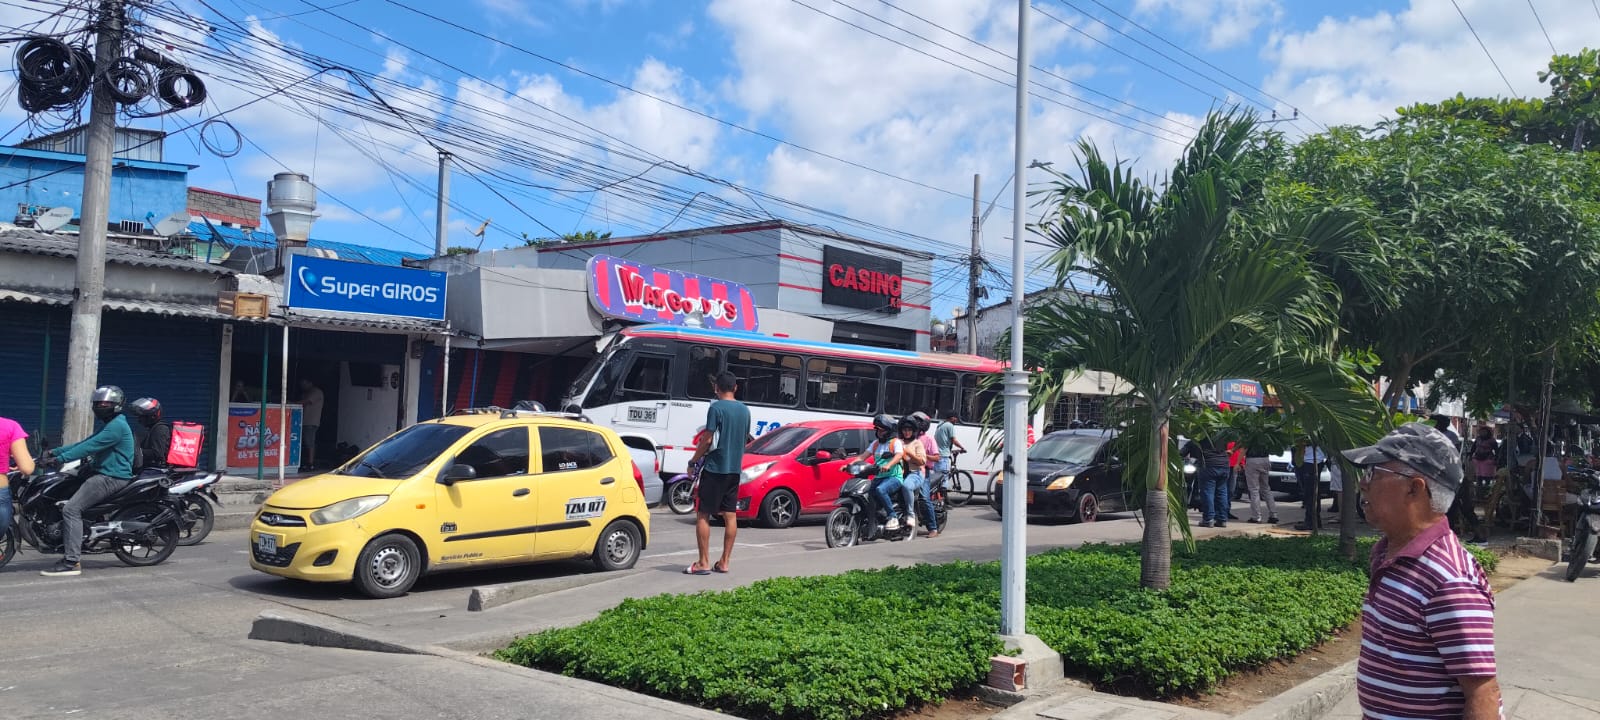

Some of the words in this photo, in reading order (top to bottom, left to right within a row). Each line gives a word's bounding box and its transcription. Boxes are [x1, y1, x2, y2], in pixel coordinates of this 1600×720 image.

[321, 276, 380, 299] Super
[382, 283, 438, 303] GIROS
[829, 263, 902, 297] CASINO
[628, 409, 643, 419] TDU
[644, 411, 656, 420] 361
[565, 502, 586, 514] TZM
[588, 501, 607, 512] 077
